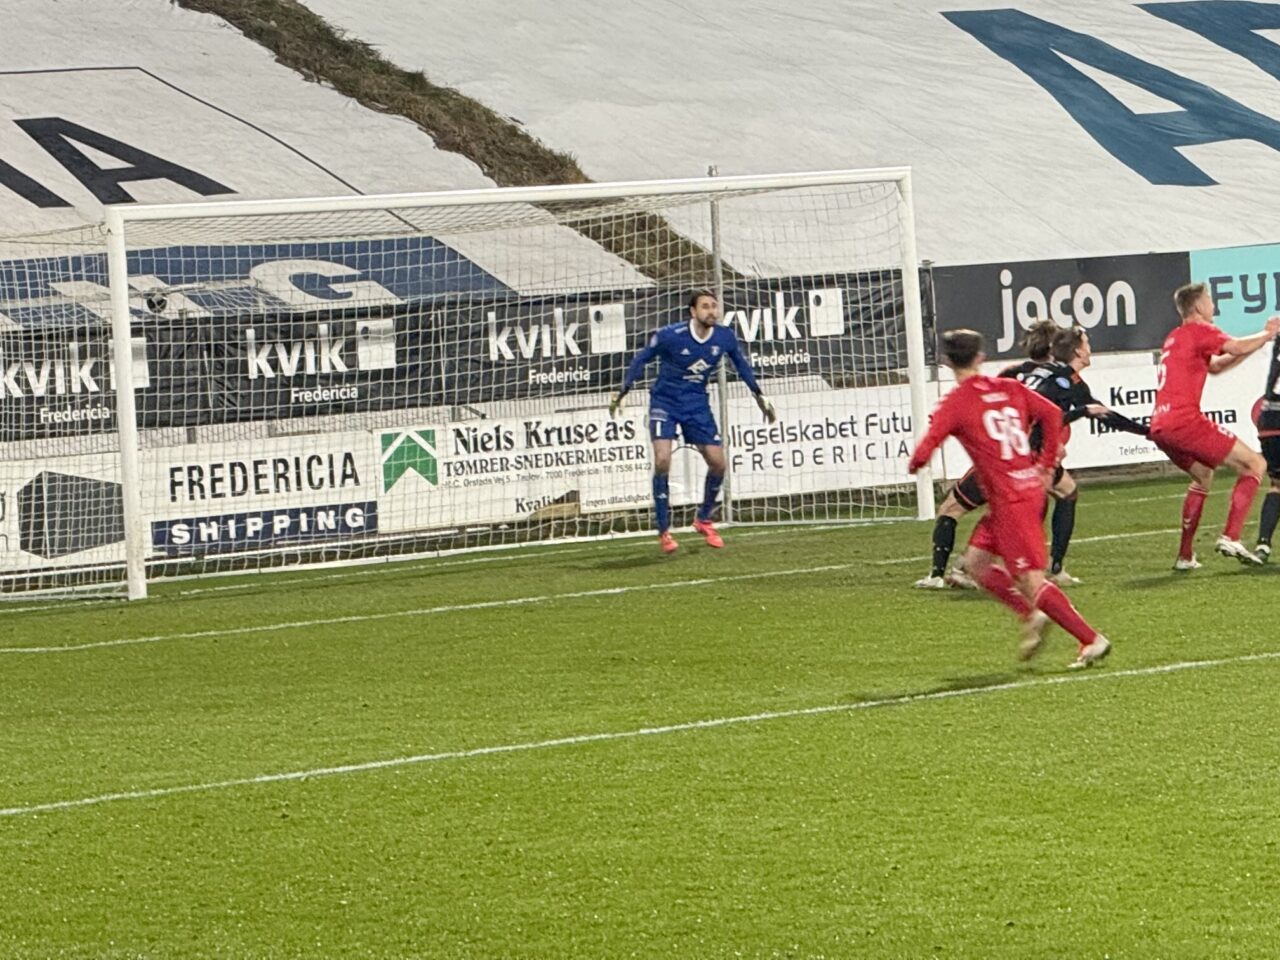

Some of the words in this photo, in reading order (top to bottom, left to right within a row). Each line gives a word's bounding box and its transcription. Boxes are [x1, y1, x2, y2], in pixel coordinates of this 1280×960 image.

[996, 269, 1137, 353] jacon
[487, 307, 582, 361] kvik
[246, 324, 349, 380] kvik
[751, 349, 811, 368] Fredericia
[528, 367, 590, 386] Fredericia
[291, 384, 358, 404] Fredericia
[40, 403, 110, 424] Fredericia
[453, 424, 515, 456] Niels
[523, 421, 600, 450] Kruse
[443, 444, 646, 478] TØMRER-SNEDKERMESTER
[732, 440, 910, 473] FREDERICIA
[169, 452, 360, 503] FREDERICIA
[171, 507, 365, 546] SHIPPING
